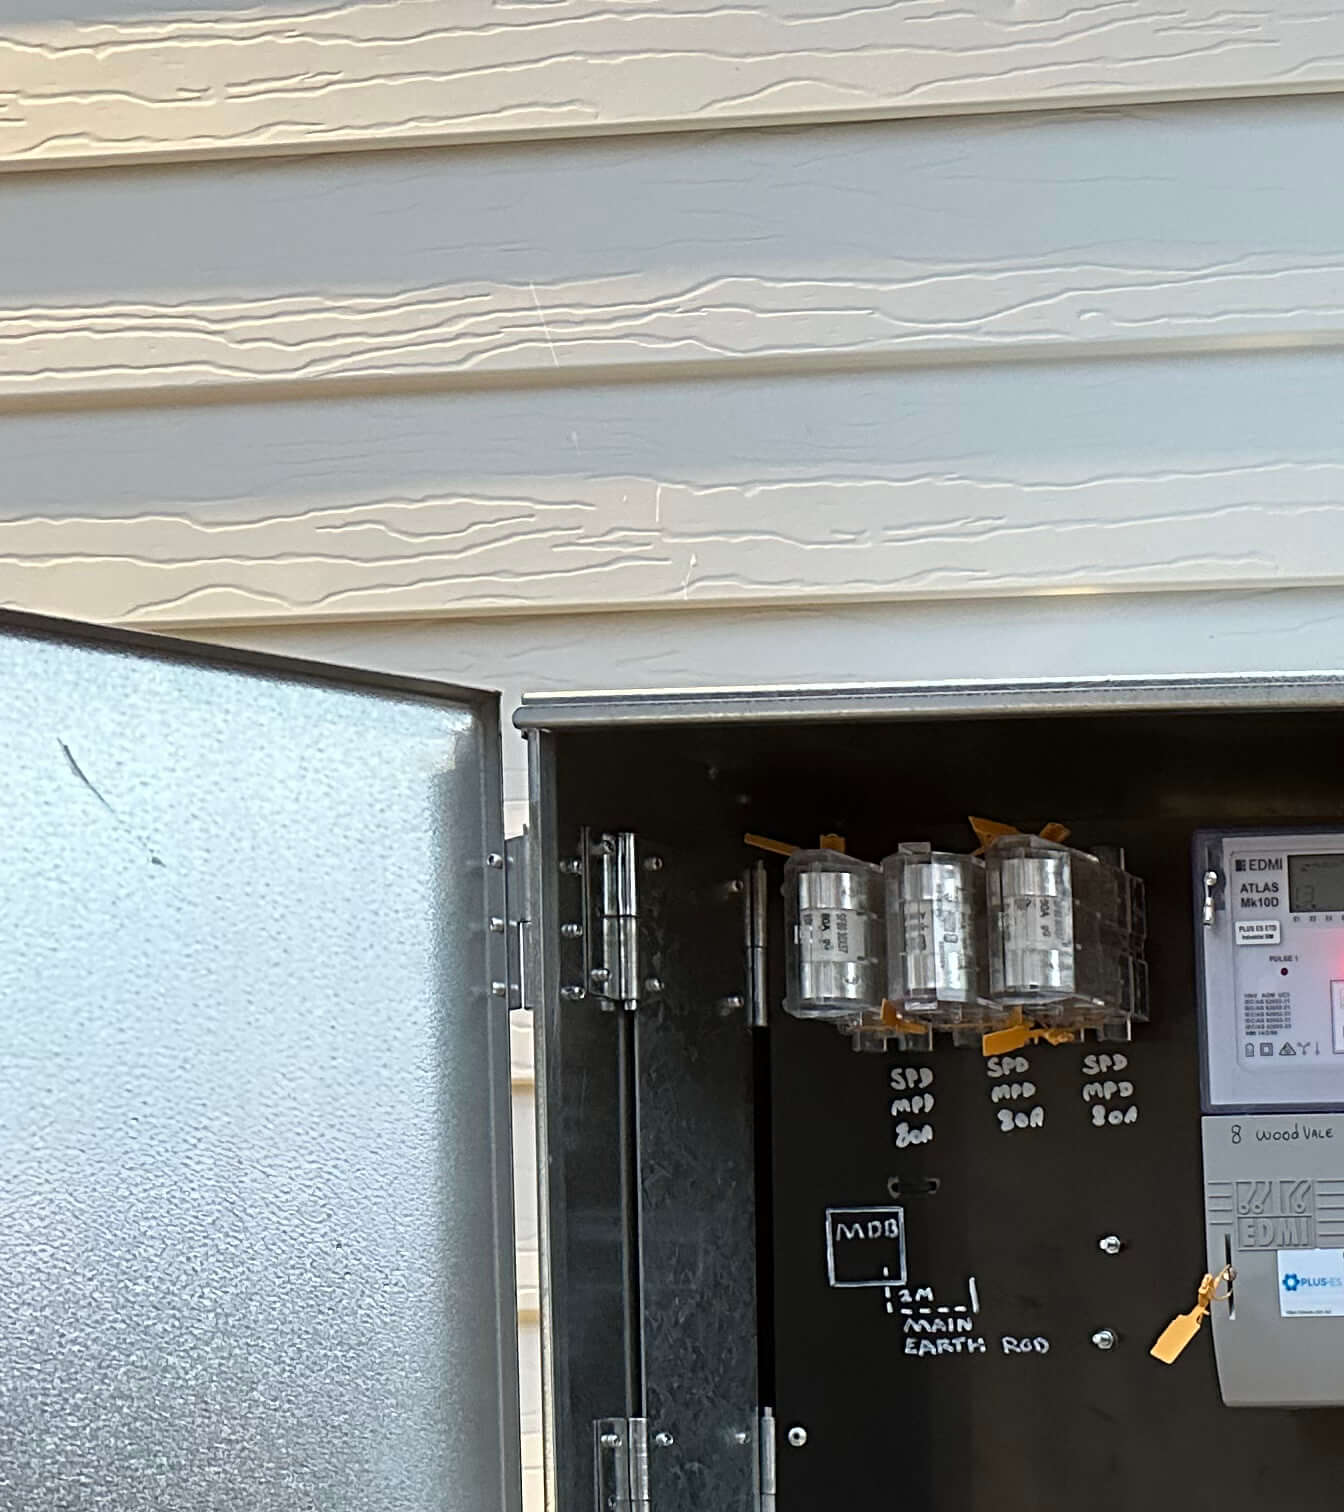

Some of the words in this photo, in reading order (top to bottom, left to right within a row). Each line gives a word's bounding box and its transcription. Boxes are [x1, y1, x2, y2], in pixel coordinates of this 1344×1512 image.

[1250, 858, 1283, 870] EDMI
[1240, 882, 1279, 894] ATLAS
[1241, 897, 1279, 908] Mk10D
[986, 1056, 1030, 1078] SPD
[1082, 1053, 1128, 1076] SPD
[890, 1067, 934, 1090] SPD
[991, 1081, 1036, 1103] MPD
[1082, 1080, 1134, 1102] MPD
[891, 1093, 935, 1116] MPD
[1231, 1124, 1242, 1144] 8
[835, 1218, 899, 1242] MDB
[1243, 1218, 1309, 1247] EDMI
[904, 1317, 973, 1333] MAIN
[905, 1337, 987, 1357] EARTH
[1001, 1336, 1050, 1354] ROD
